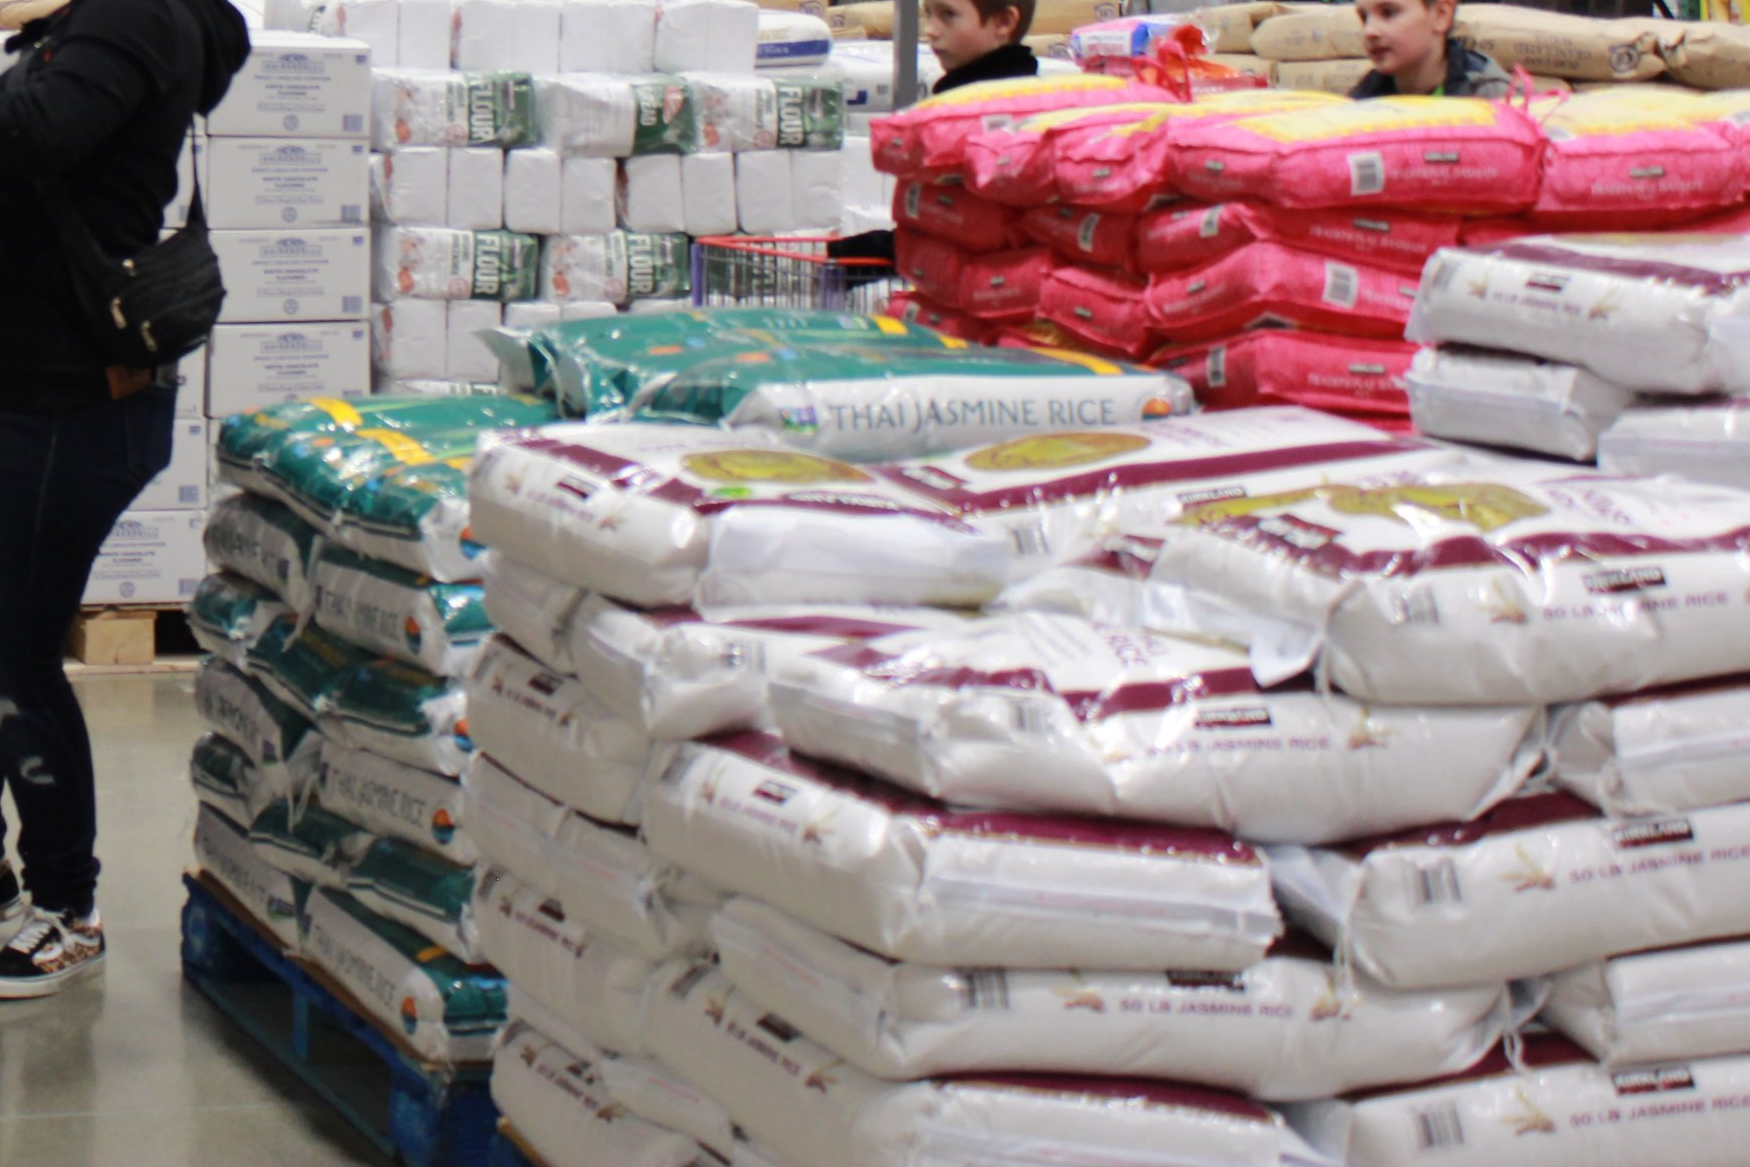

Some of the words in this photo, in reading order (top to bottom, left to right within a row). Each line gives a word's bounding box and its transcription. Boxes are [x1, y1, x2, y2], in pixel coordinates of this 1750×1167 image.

[470, 80, 495, 141] FLOUR
[778, 85, 804, 146] FLOUR
[475, 235, 501, 295] FLOUR
[628, 234, 655, 295] FLOUR
[828, 401, 905, 433] THAI
[911, 398, 1039, 435] JASMINE
[1049, 397, 1118, 427] RICE
[1177, 999, 1253, 1016] JASMINE
[1626, 1098, 1705, 1121] JASMINE
